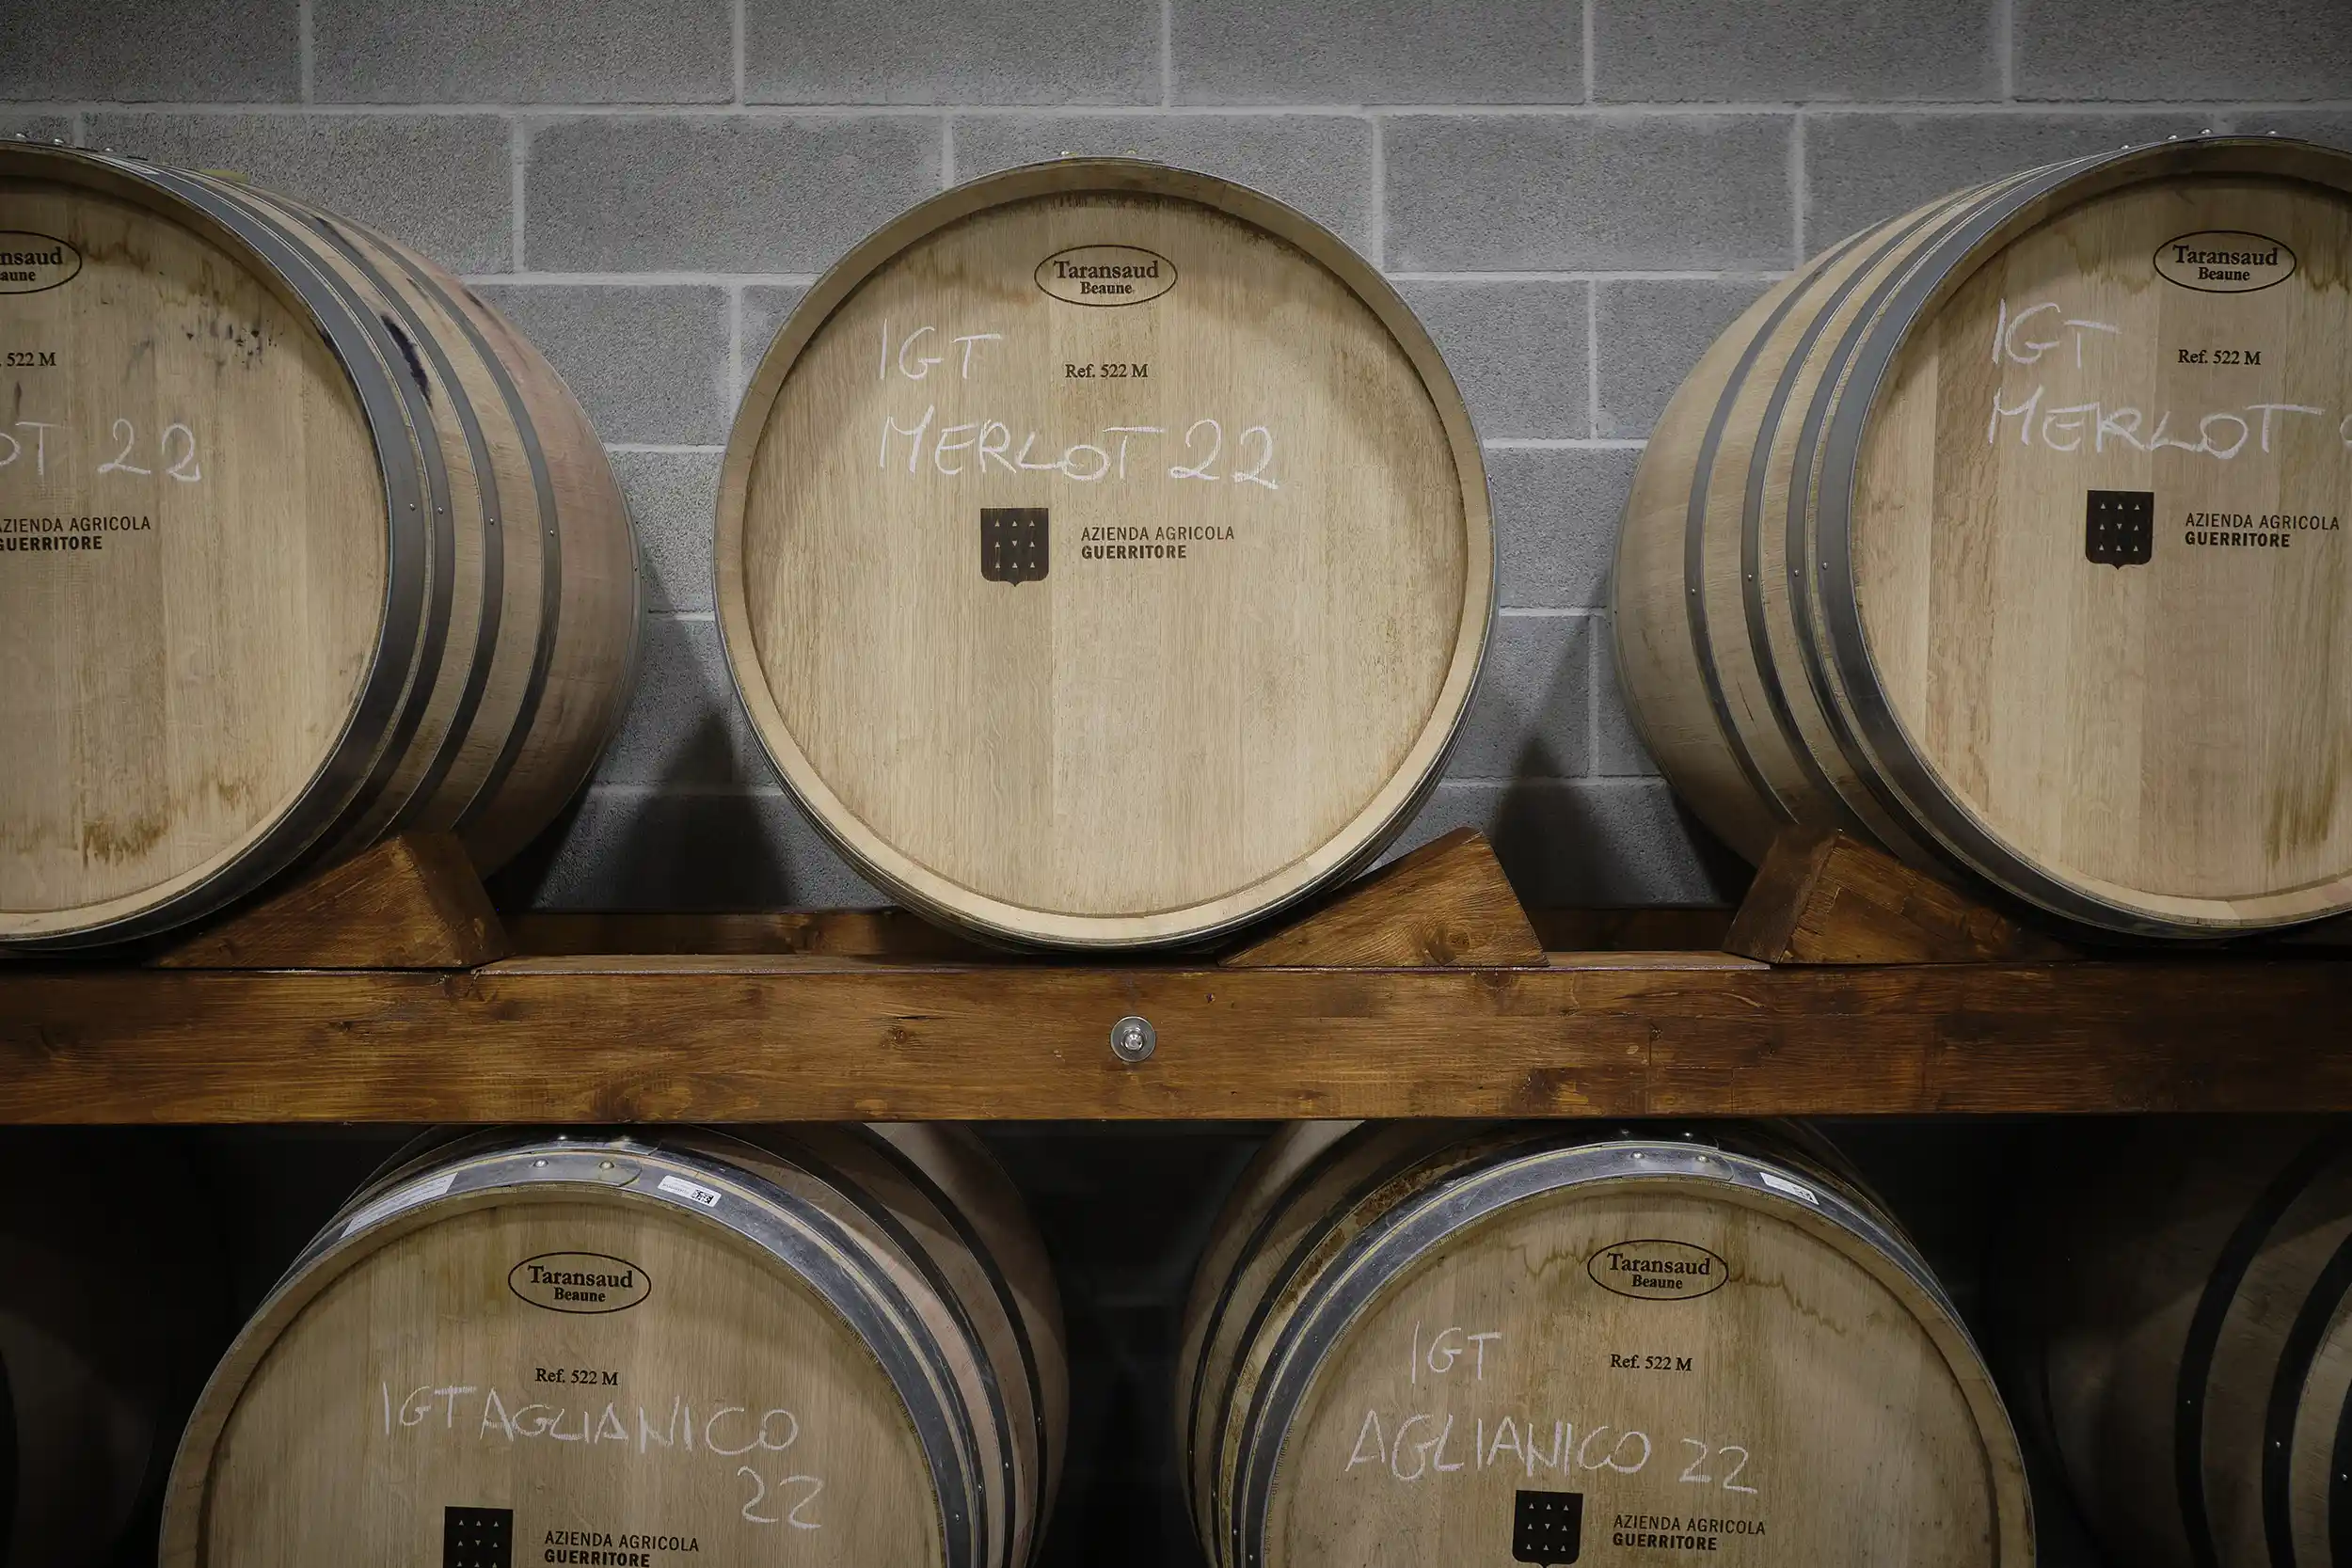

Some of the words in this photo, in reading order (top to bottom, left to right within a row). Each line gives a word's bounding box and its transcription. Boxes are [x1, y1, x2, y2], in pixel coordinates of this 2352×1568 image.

[2172, 245, 2279, 266] Taransaud
[1054, 260, 1159, 280] Taransaud
[2198, 267, 2250, 281] Beaune
[1080, 282, 1133, 295] Beaune
[1992, 298, 2122, 368] IGT
[880, 319, 1002, 379] IGT
[2178, 349, 2208, 364] Ref.
[2213, 350, 2240, 365] 522
[2244, 351, 2262, 365] M
[7, 353, 34, 367] 522
[38, 353, 56, 367] M
[1065, 363, 1096, 378] Ref.
[1101, 363, 1127, 378] 522
[1131, 363, 1149, 378] M
[1989, 385, 2325, 460] MERLOT
[97, 418, 202, 482] 22
[878, 404, 1167, 482] MERLOT
[1169, 419, 1279, 490] 22
[0, 518, 63, 533] ZIENDA
[70, 516, 151, 531] AGRICOLA
[2185, 513, 2253, 529] AZIENDA
[2259, 515, 2340, 531] AGRICOLA
[1081, 527, 1150, 541] AZIENDA
[1155, 527, 1235, 541] AGRICOLA
[2185, 531, 2291, 547] GUERRITORE
[1081, 546, 1186, 560] GUERRITORE
[1607, 1252, 1710, 1276] Taransaud
[528, 1265, 633, 1289] Taransaud
[1631, 1275, 1683, 1290] Beaune
[553, 1288, 606, 1303] Beaune
[1411, 1321, 1502, 1384] IGT
[1610, 1354, 1640, 1370] Ref.
[1645, 1355, 1672, 1370] 522
[1676, 1357, 1692, 1371] M
[534, 1368, 565, 1383] Ref.
[571, 1370, 597, 1385] 522
[601, 1370, 619, 1386] M
[1344, 1409, 1651, 1481] AGLIANICO
[1678, 1438, 1758, 1494] 22
[738, 1465, 824, 1528] 22
[1613, 1514, 1681, 1531] AZIENDA
[1687, 1517, 1766, 1536] AGRICOLA
[545, 1530, 612, 1547] AZIENDA
[618, 1534, 699, 1552] AGRICOLA
[1613, 1533, 1717, 1551] GUERRITORE
[544, 1548, 650, 1568] GUERRITORE
